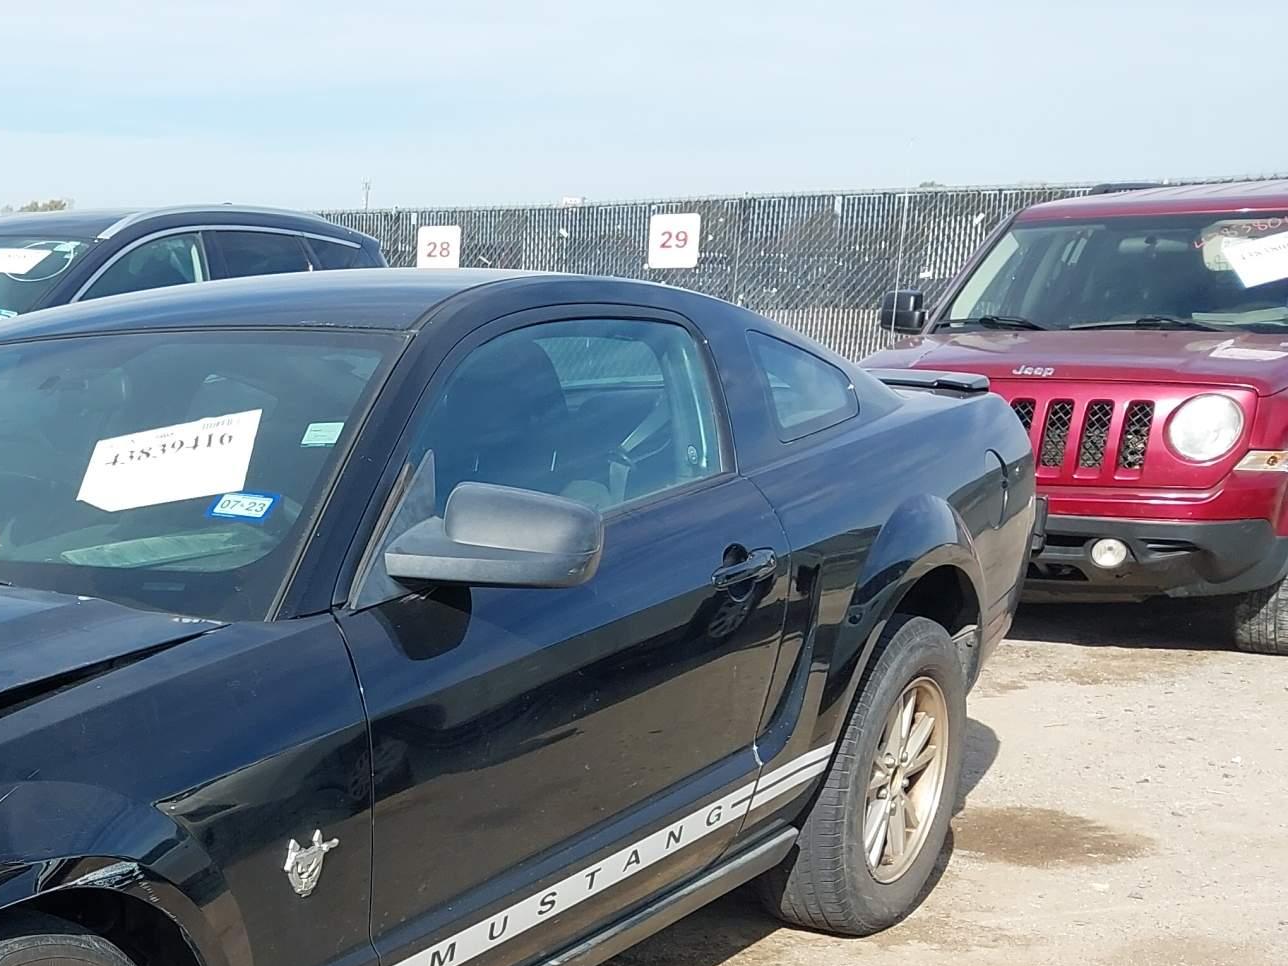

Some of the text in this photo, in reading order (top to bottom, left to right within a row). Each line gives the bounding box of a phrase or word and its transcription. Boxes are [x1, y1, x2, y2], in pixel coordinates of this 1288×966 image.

[660, 230, 688, 248] 29
[426, 241, 450, 257] 28
[1012, 364, 1055, 376] Jeep
